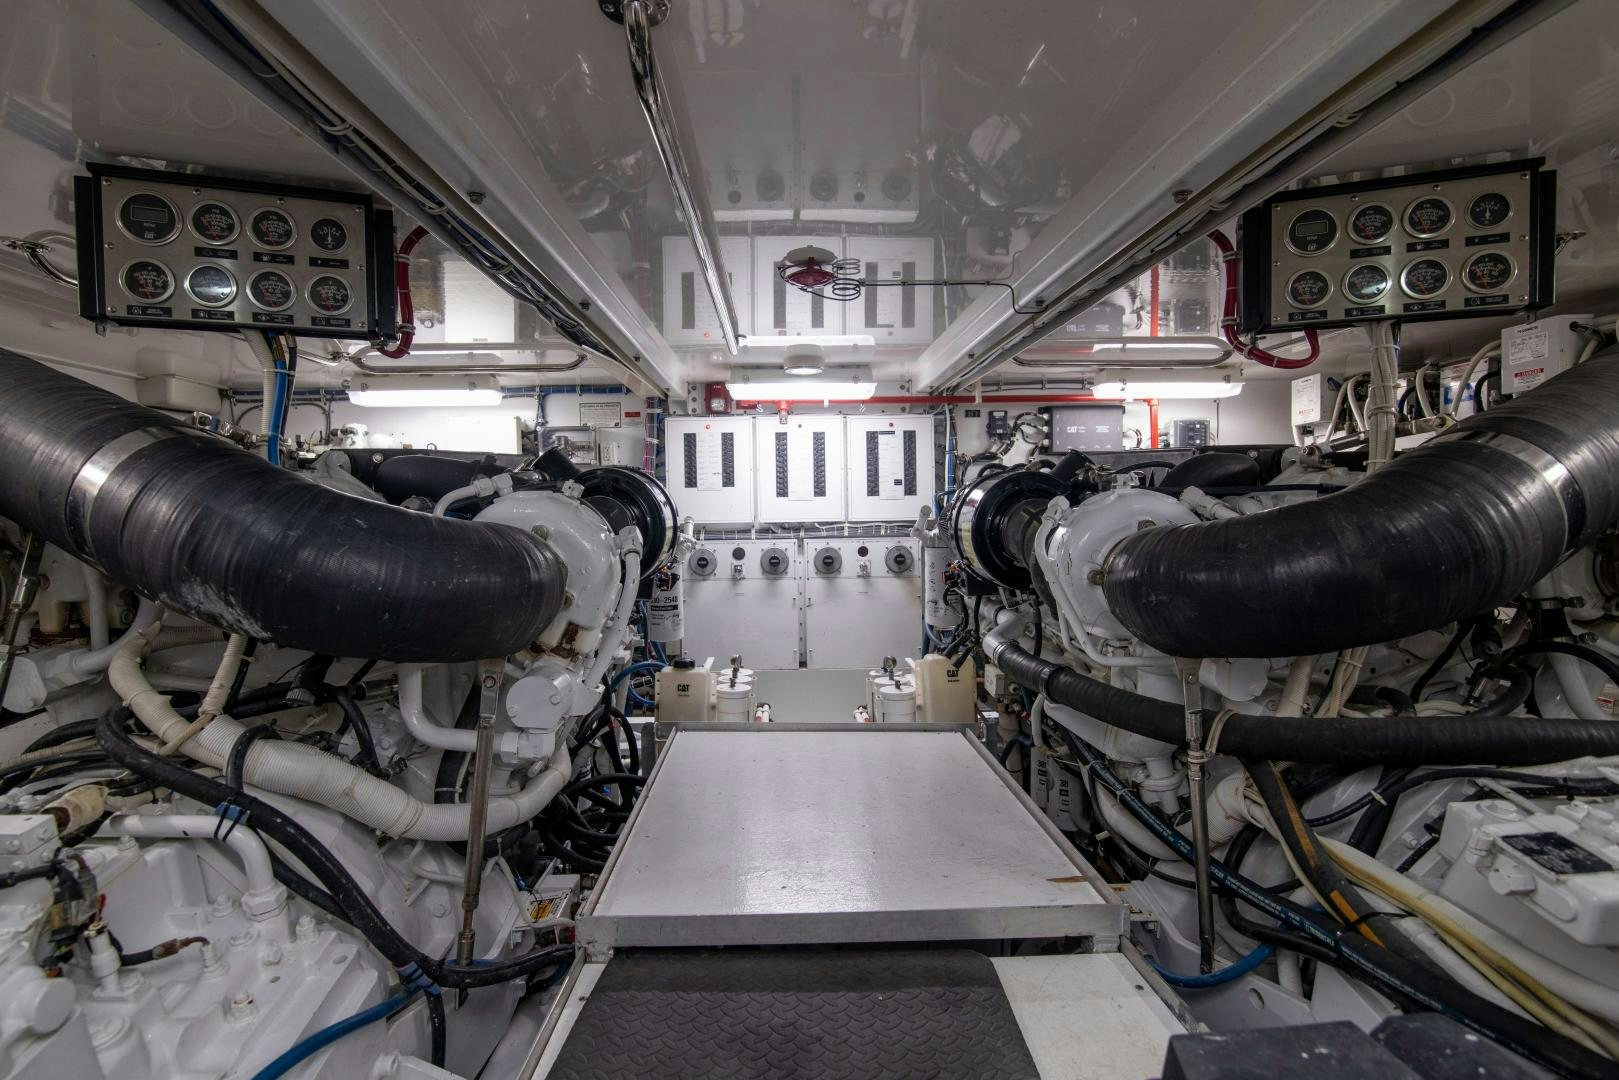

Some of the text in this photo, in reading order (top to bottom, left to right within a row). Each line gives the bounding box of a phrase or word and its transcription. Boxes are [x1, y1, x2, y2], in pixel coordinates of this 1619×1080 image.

[1066, 425, 1078, 433] CAT
[946, 669, 960, 678] CAT
[677, 683, 690, 692] CAT
